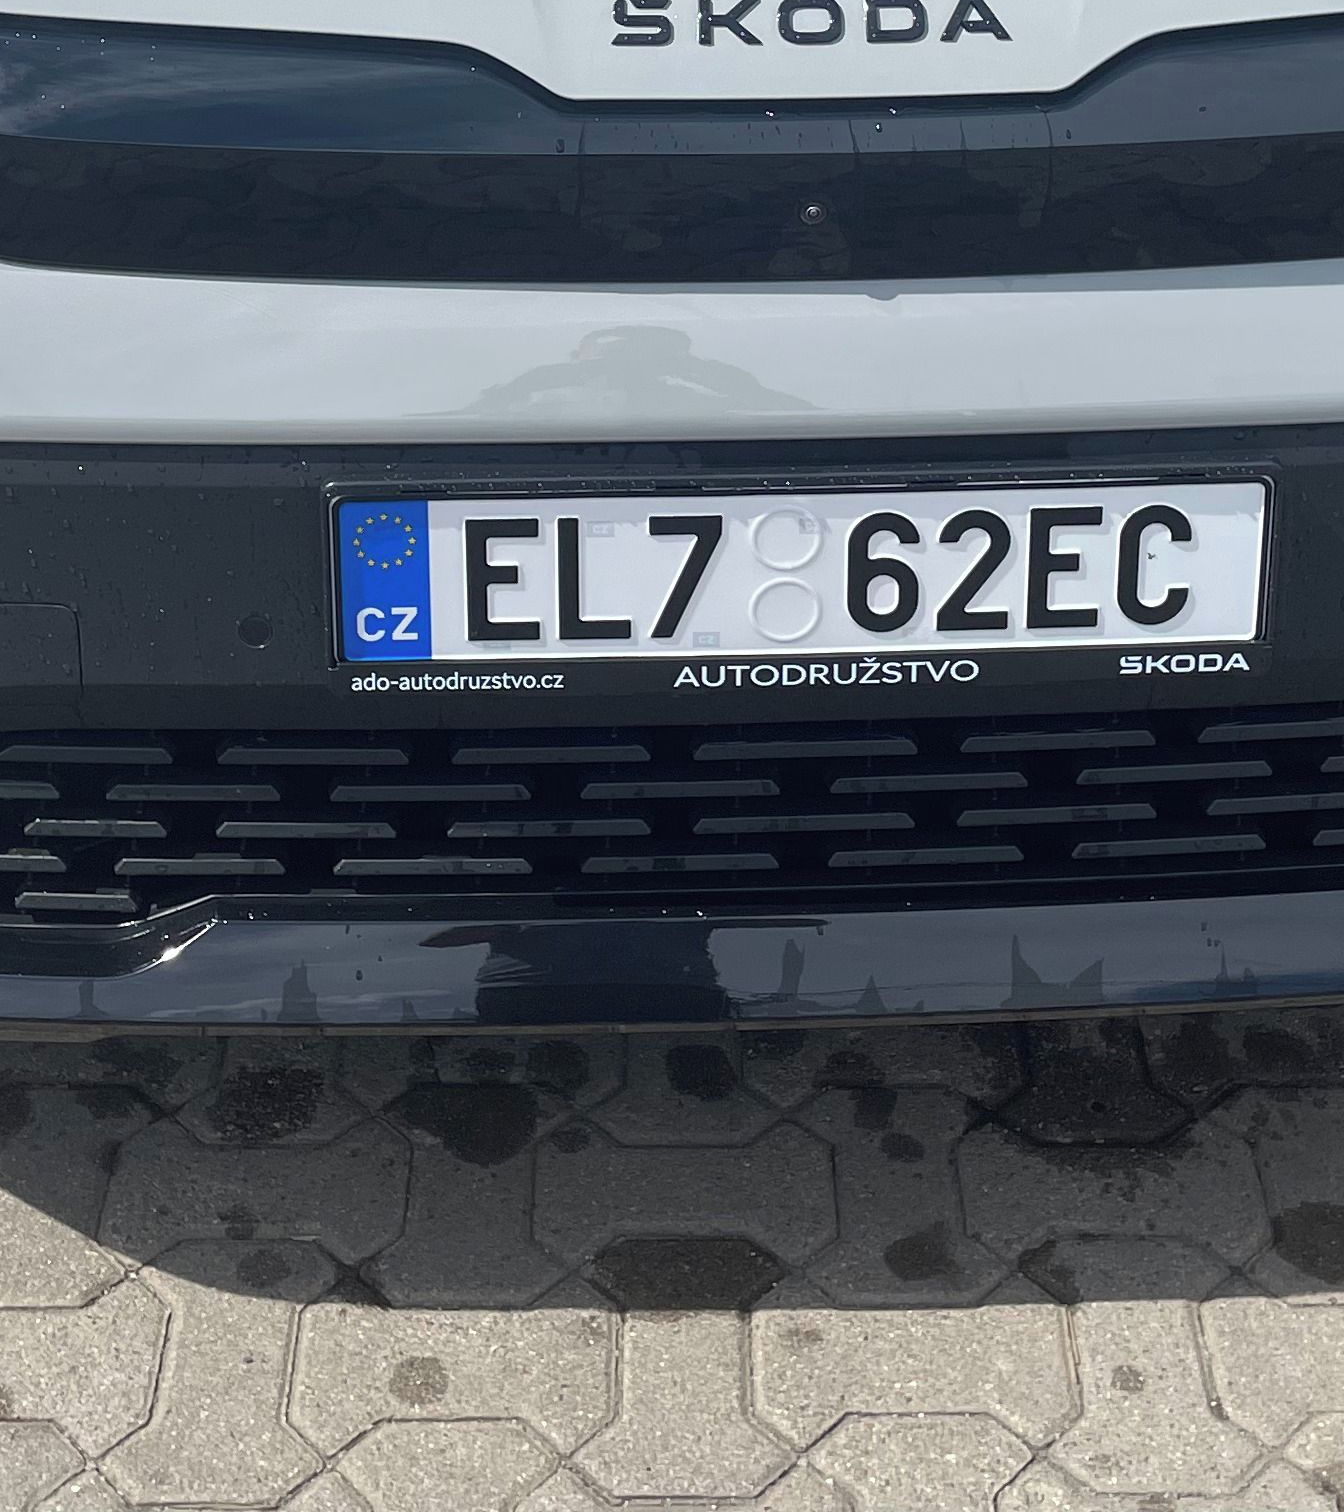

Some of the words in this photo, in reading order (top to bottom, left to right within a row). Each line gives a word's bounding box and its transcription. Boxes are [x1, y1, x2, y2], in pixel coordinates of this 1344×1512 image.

[464, 514, 723, 641] EL7
[846, 504, 1193, 633] 62EC
[356, 606, 420, 642] CZ
[673, 656, 980, 688] AUTODRUŽSTVO
[1119, 652, 1250, 675] SKODA
[350, 671, 565, 692] ado-autodruzstvo.cz
